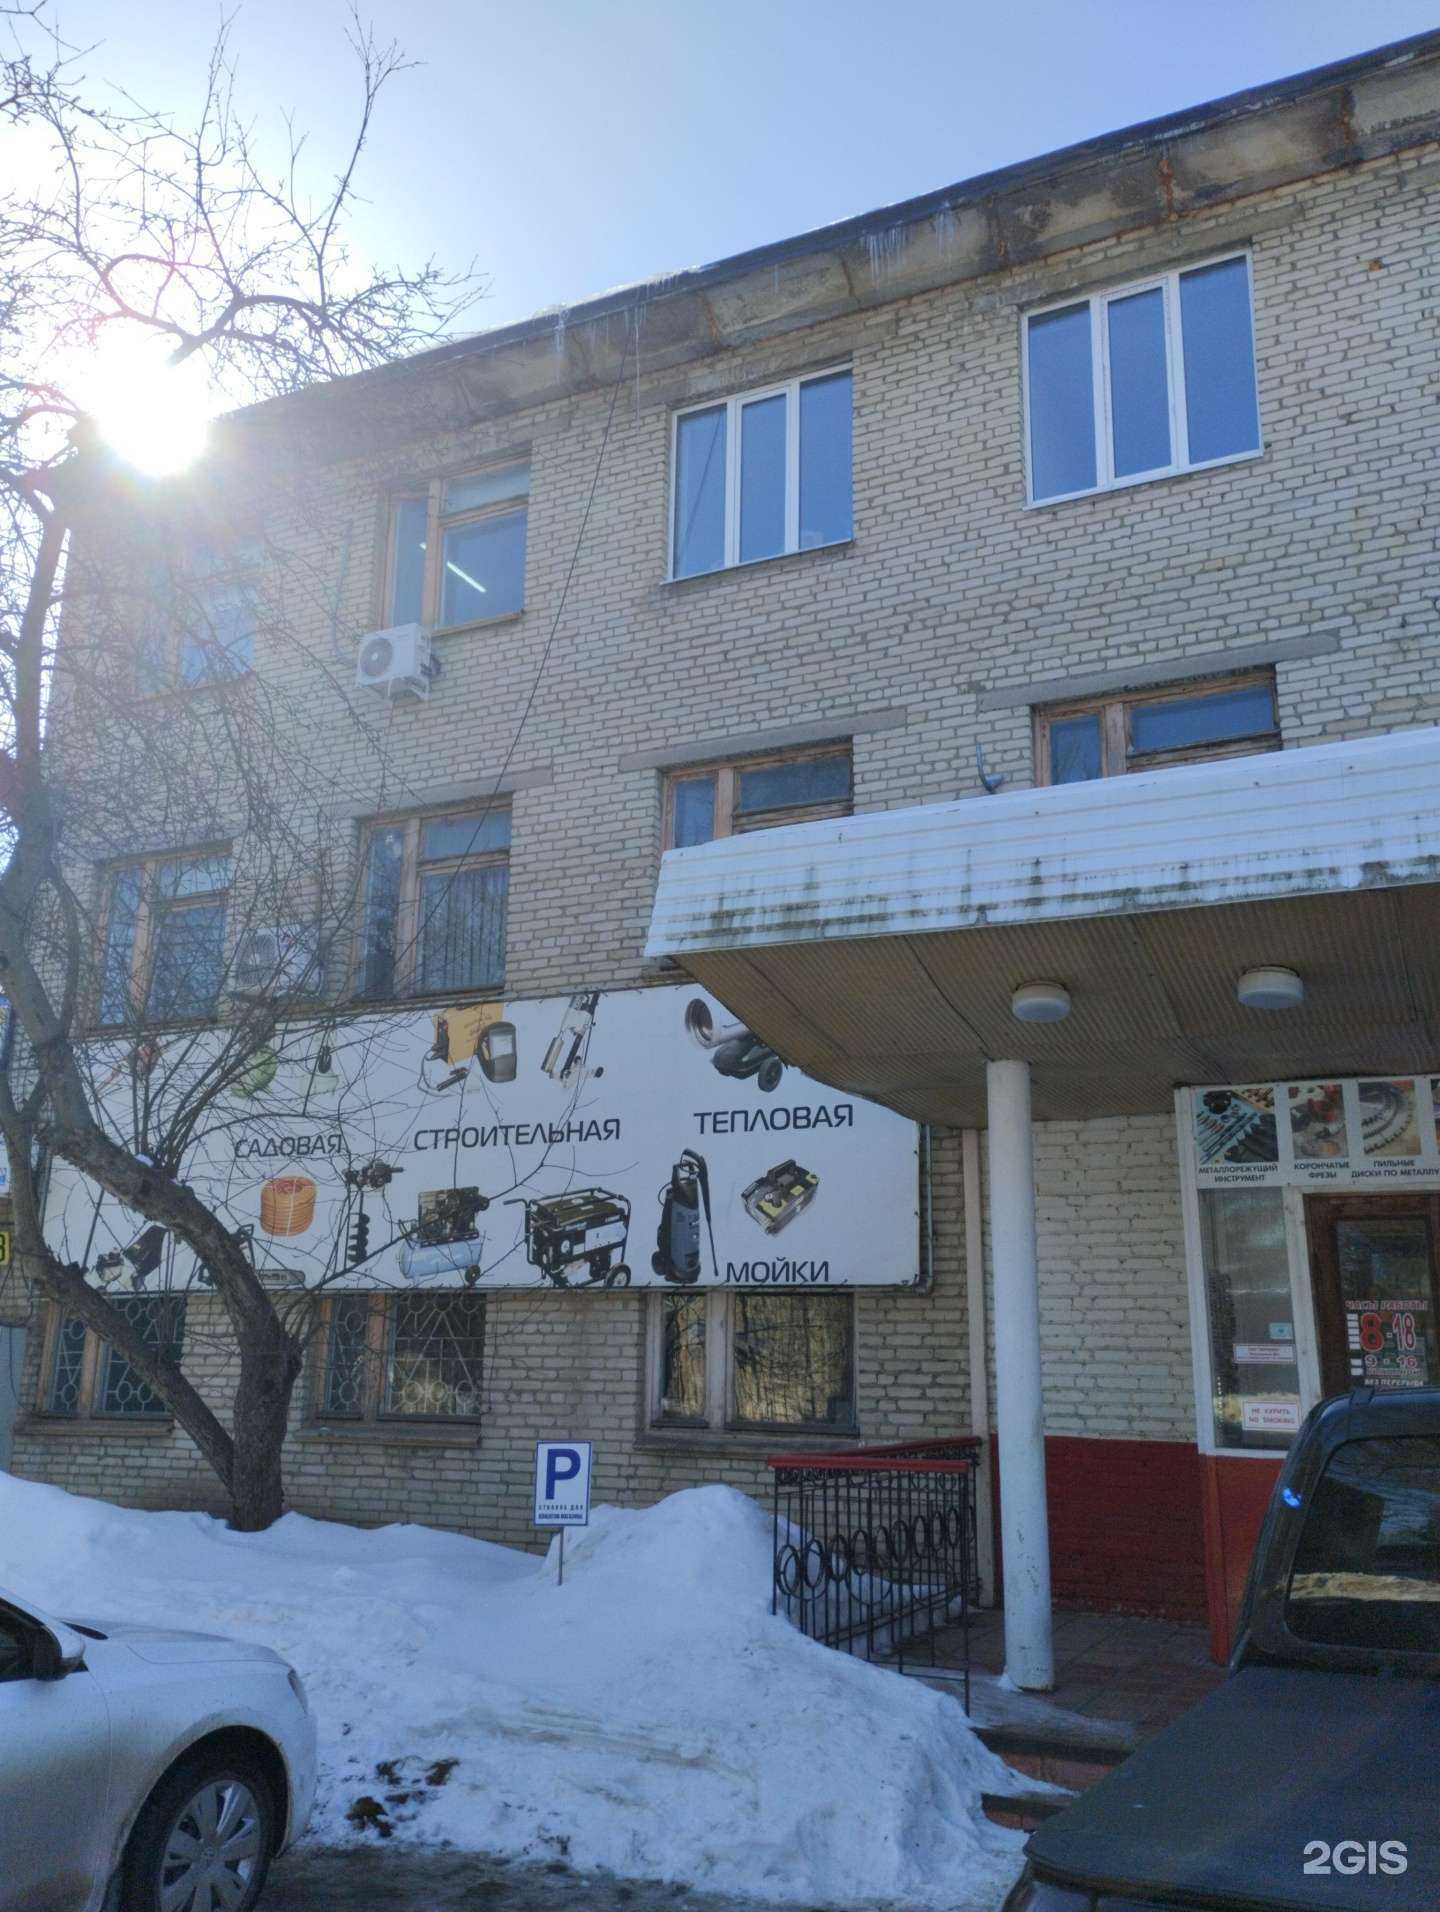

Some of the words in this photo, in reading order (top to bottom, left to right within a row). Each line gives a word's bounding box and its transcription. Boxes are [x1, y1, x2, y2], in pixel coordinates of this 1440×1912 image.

[694, 1104, 854, 1134] ТЕПЛОВАЯ
[414, 1118, 621, 1151] СТРОИТЕЛЬНАЯ
[234, 1134, 343, 1159] САДОВАЯ
[1199, 1164, 1278, 1174] МЕТАЛЛОРЕЖУЩИЙ
[1294, 1161, 1349, 1170] КОРОНЧАТЫЕ
[1373, 1159, 1415, 1168] ПИЛЬНЫЕ
[1308, 1171, 1337, 1179] ФРЕЗЫ
[1351, 1169, 1381, 1178] ДИСКИ
[1383, 1169, 1398, 1177] ПО
[1400, 1167, 1440, 1176] МЕТАЛЛУ
[1214, 1174, 1265, 1183] ИНСТРУМЕНТ
[727, 1257, 829, 1283] МОЙКИ
[545, 1448, 581, 1500] P
